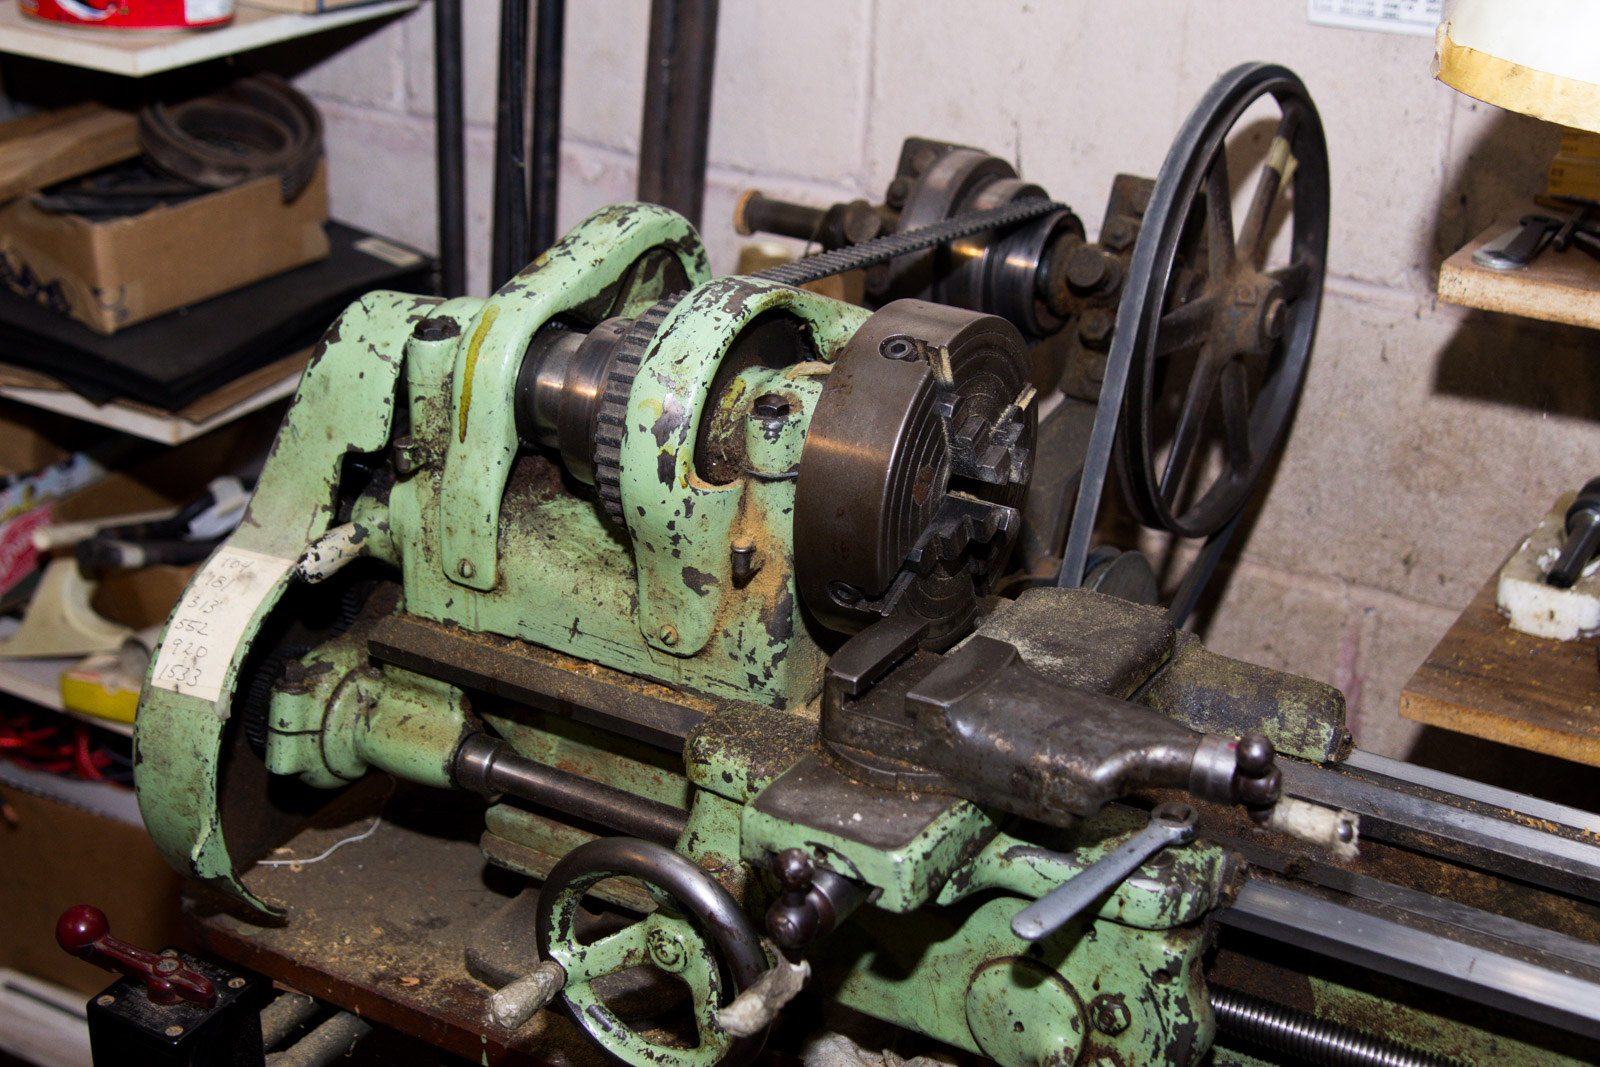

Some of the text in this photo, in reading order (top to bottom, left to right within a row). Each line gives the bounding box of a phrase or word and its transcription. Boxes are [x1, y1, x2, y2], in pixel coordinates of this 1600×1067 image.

[187, 595, 220, 614] 313
[174, 618, 209, 636] 552
[172, 638, 208, 659] 920
[158, 663, 202, 687] 1533
